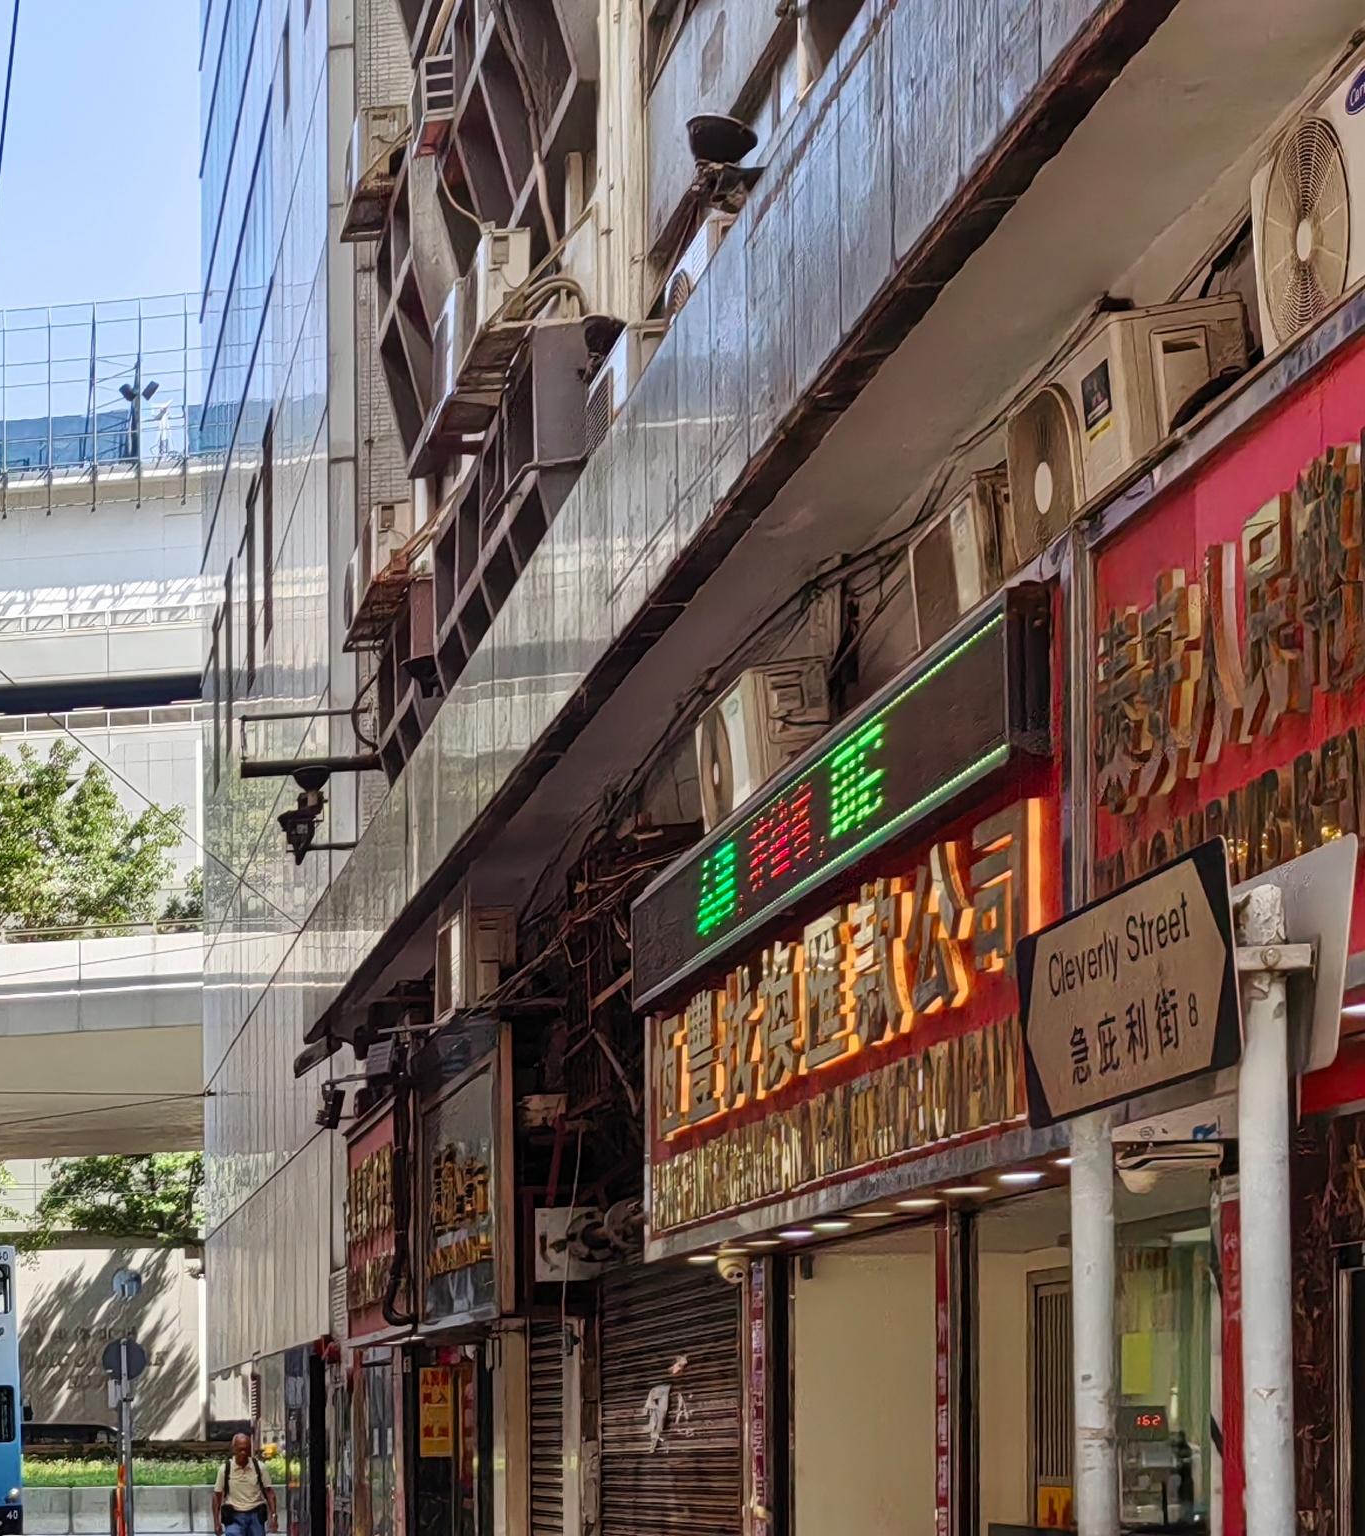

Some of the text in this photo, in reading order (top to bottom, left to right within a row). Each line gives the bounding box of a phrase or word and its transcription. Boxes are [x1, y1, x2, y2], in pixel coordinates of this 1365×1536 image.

[1049, 893, 1190, 997] Cleverly Street
[1070, 988, 1199, 1085] 急庇利街 8
[6, 1509, 19, 1520] 40
